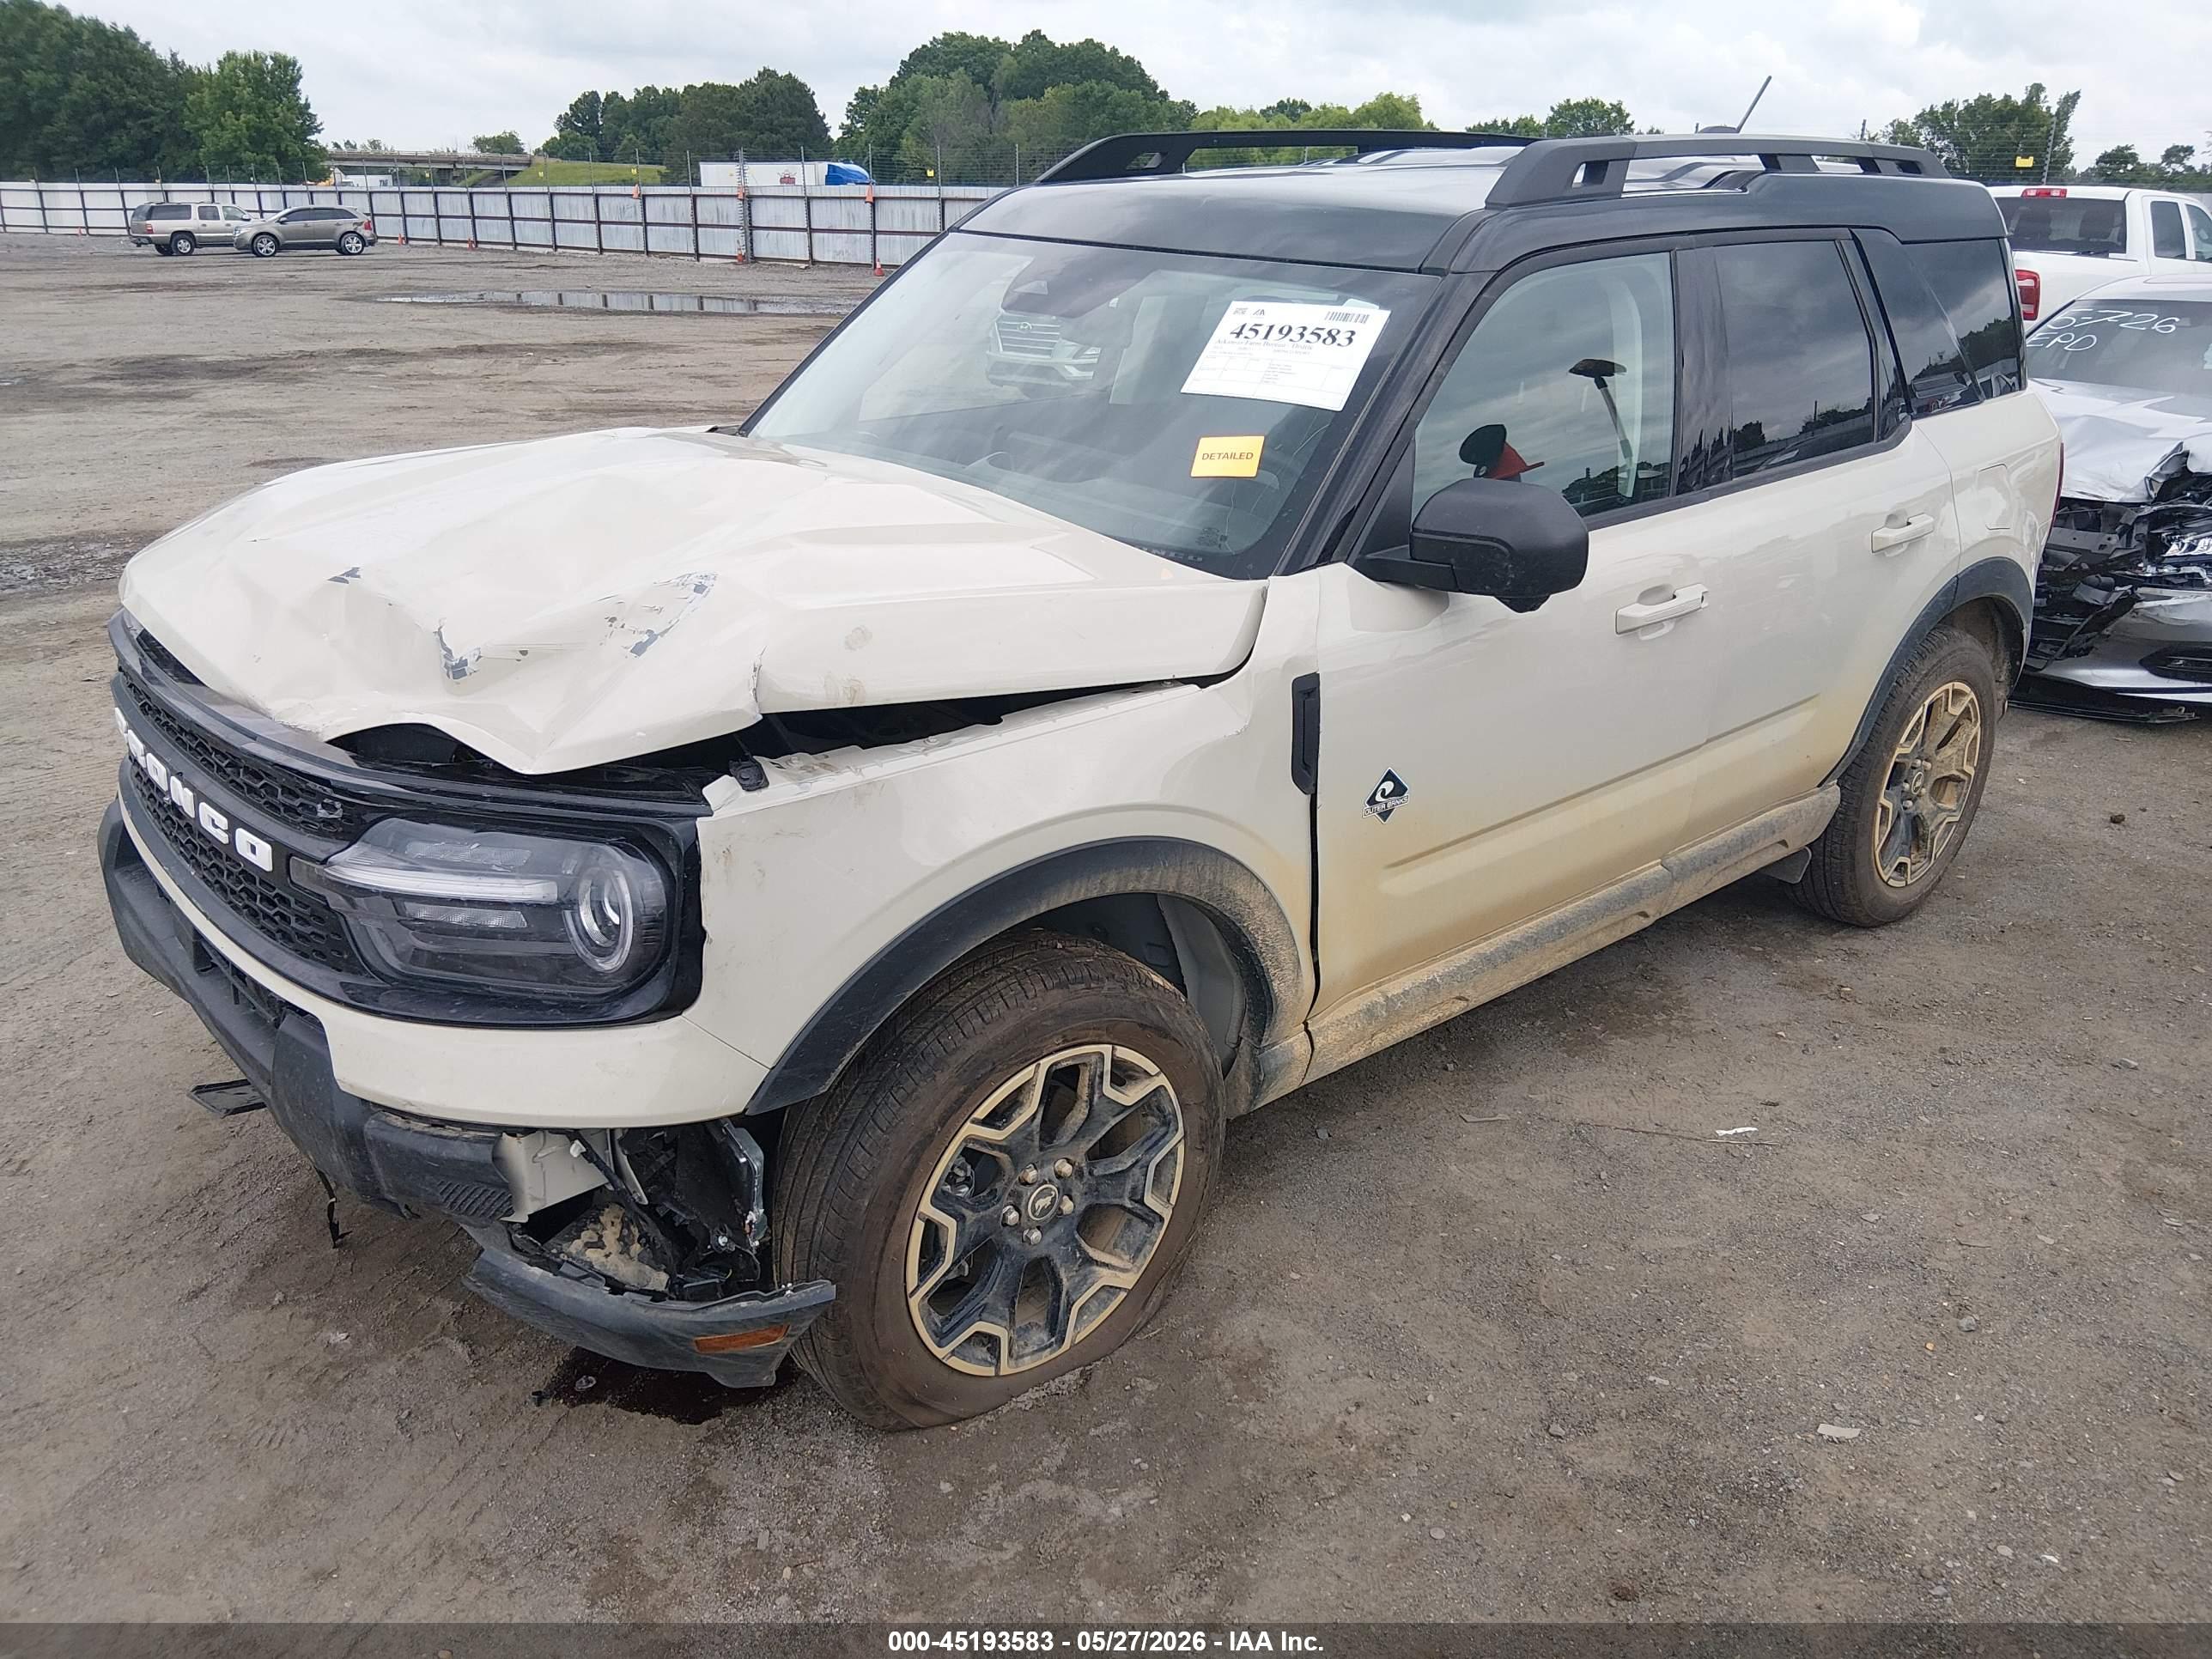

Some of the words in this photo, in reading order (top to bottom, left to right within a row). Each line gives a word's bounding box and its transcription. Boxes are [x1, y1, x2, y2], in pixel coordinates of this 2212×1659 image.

[1230, 323, 1356, 348] 45193583
[1201, 451, 1254, 461] DETAILED
[1364, 803, 1386, 816] OUTER
